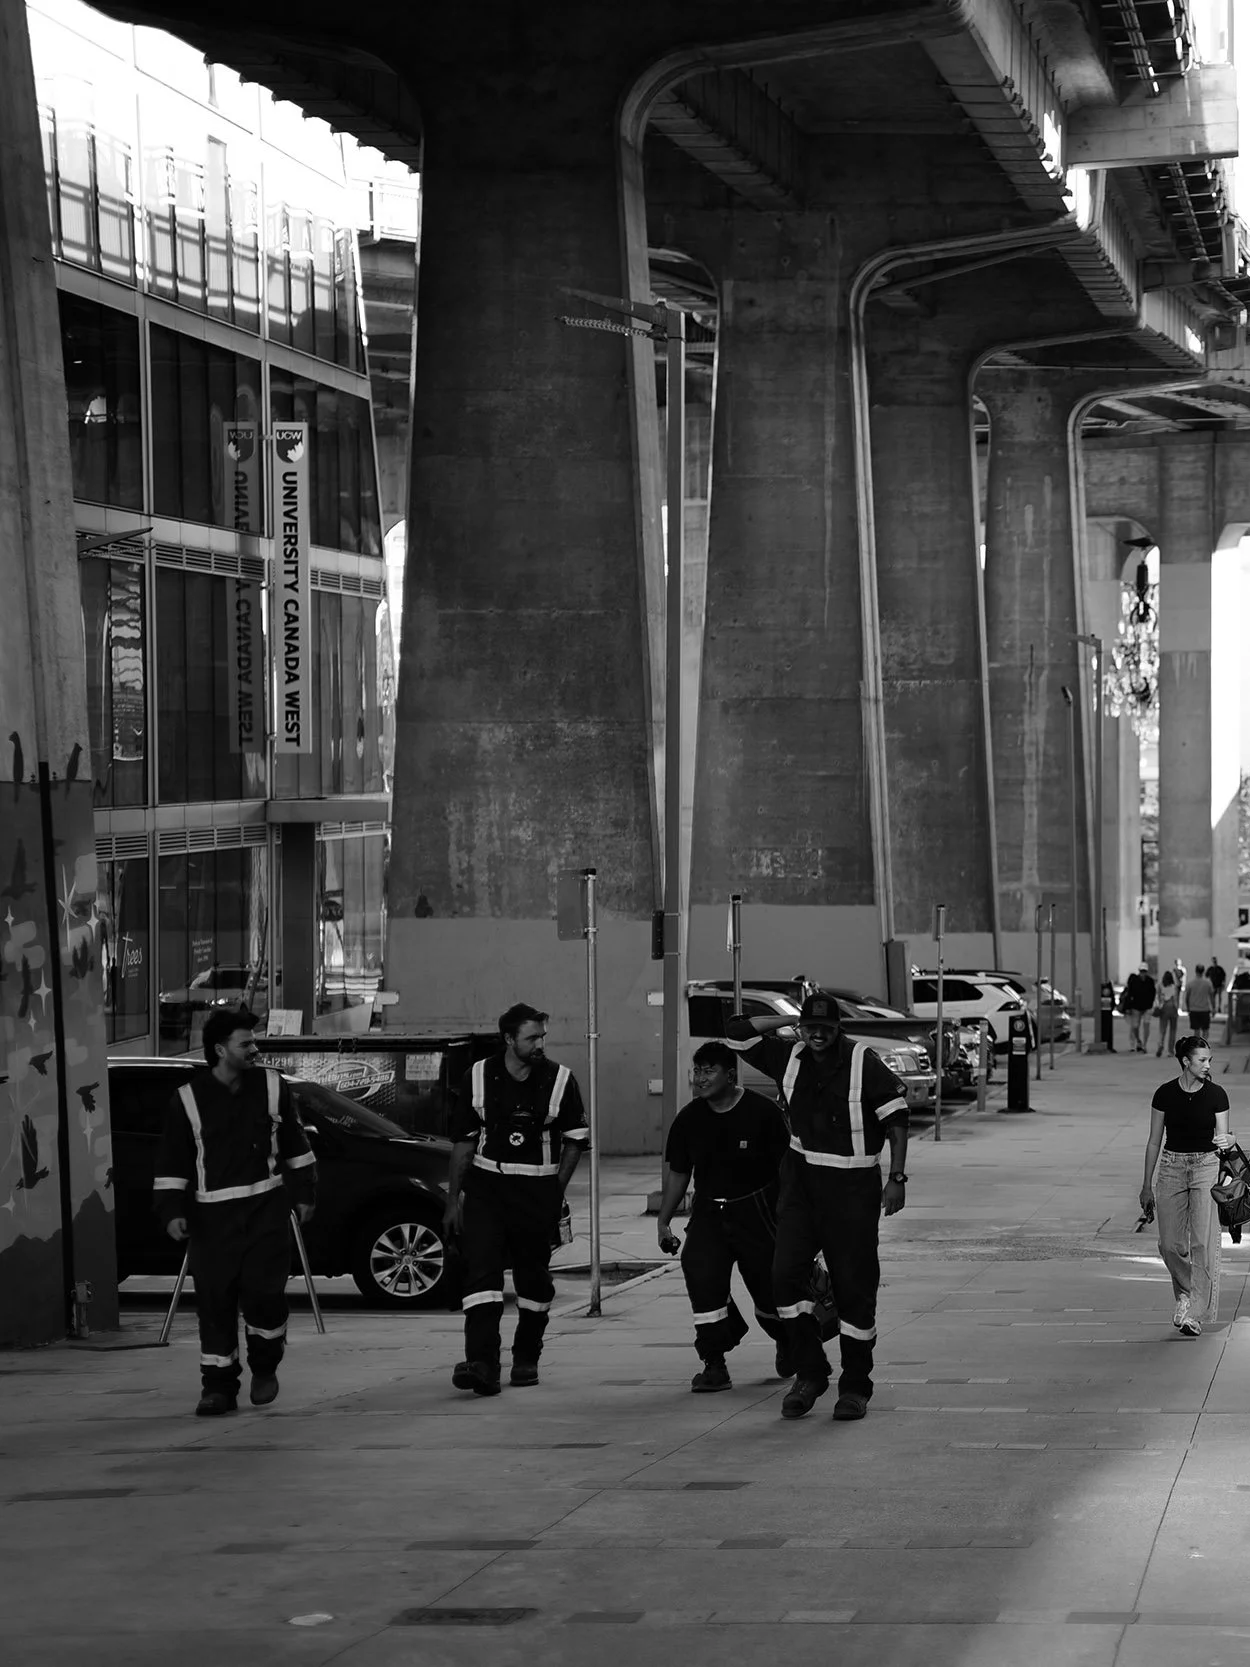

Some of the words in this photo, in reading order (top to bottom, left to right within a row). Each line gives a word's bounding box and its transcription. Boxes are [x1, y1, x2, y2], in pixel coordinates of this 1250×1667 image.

[276, 431, 302, 440] UCW
[282, 471, 300, 593] UNIVERSITY
[283, 598, 300, 685] CANADA
[284, 690, 301, 748] WEST
[121, 931, 143, 979] Trees
